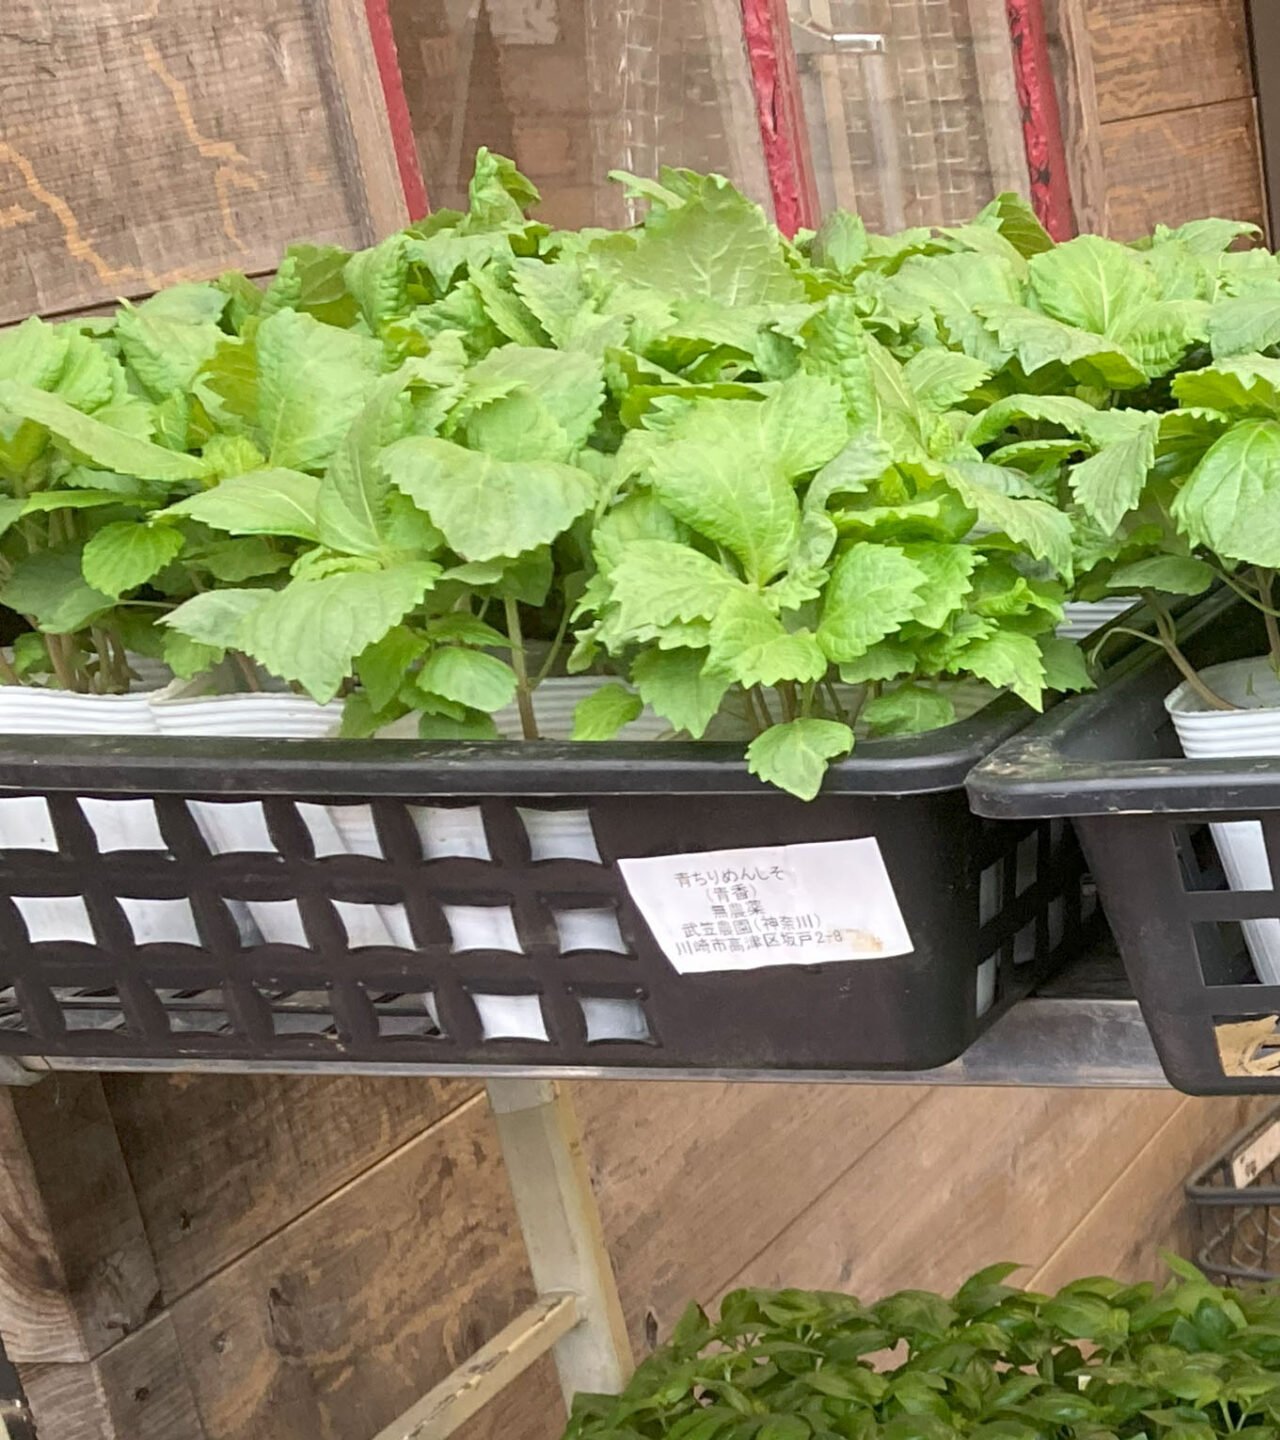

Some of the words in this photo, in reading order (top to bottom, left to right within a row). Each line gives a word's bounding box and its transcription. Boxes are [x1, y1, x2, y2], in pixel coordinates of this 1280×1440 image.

[674, 864, 785, 888] 青ちりめんしそ
[711, 899, 765, 919] 無農薬
